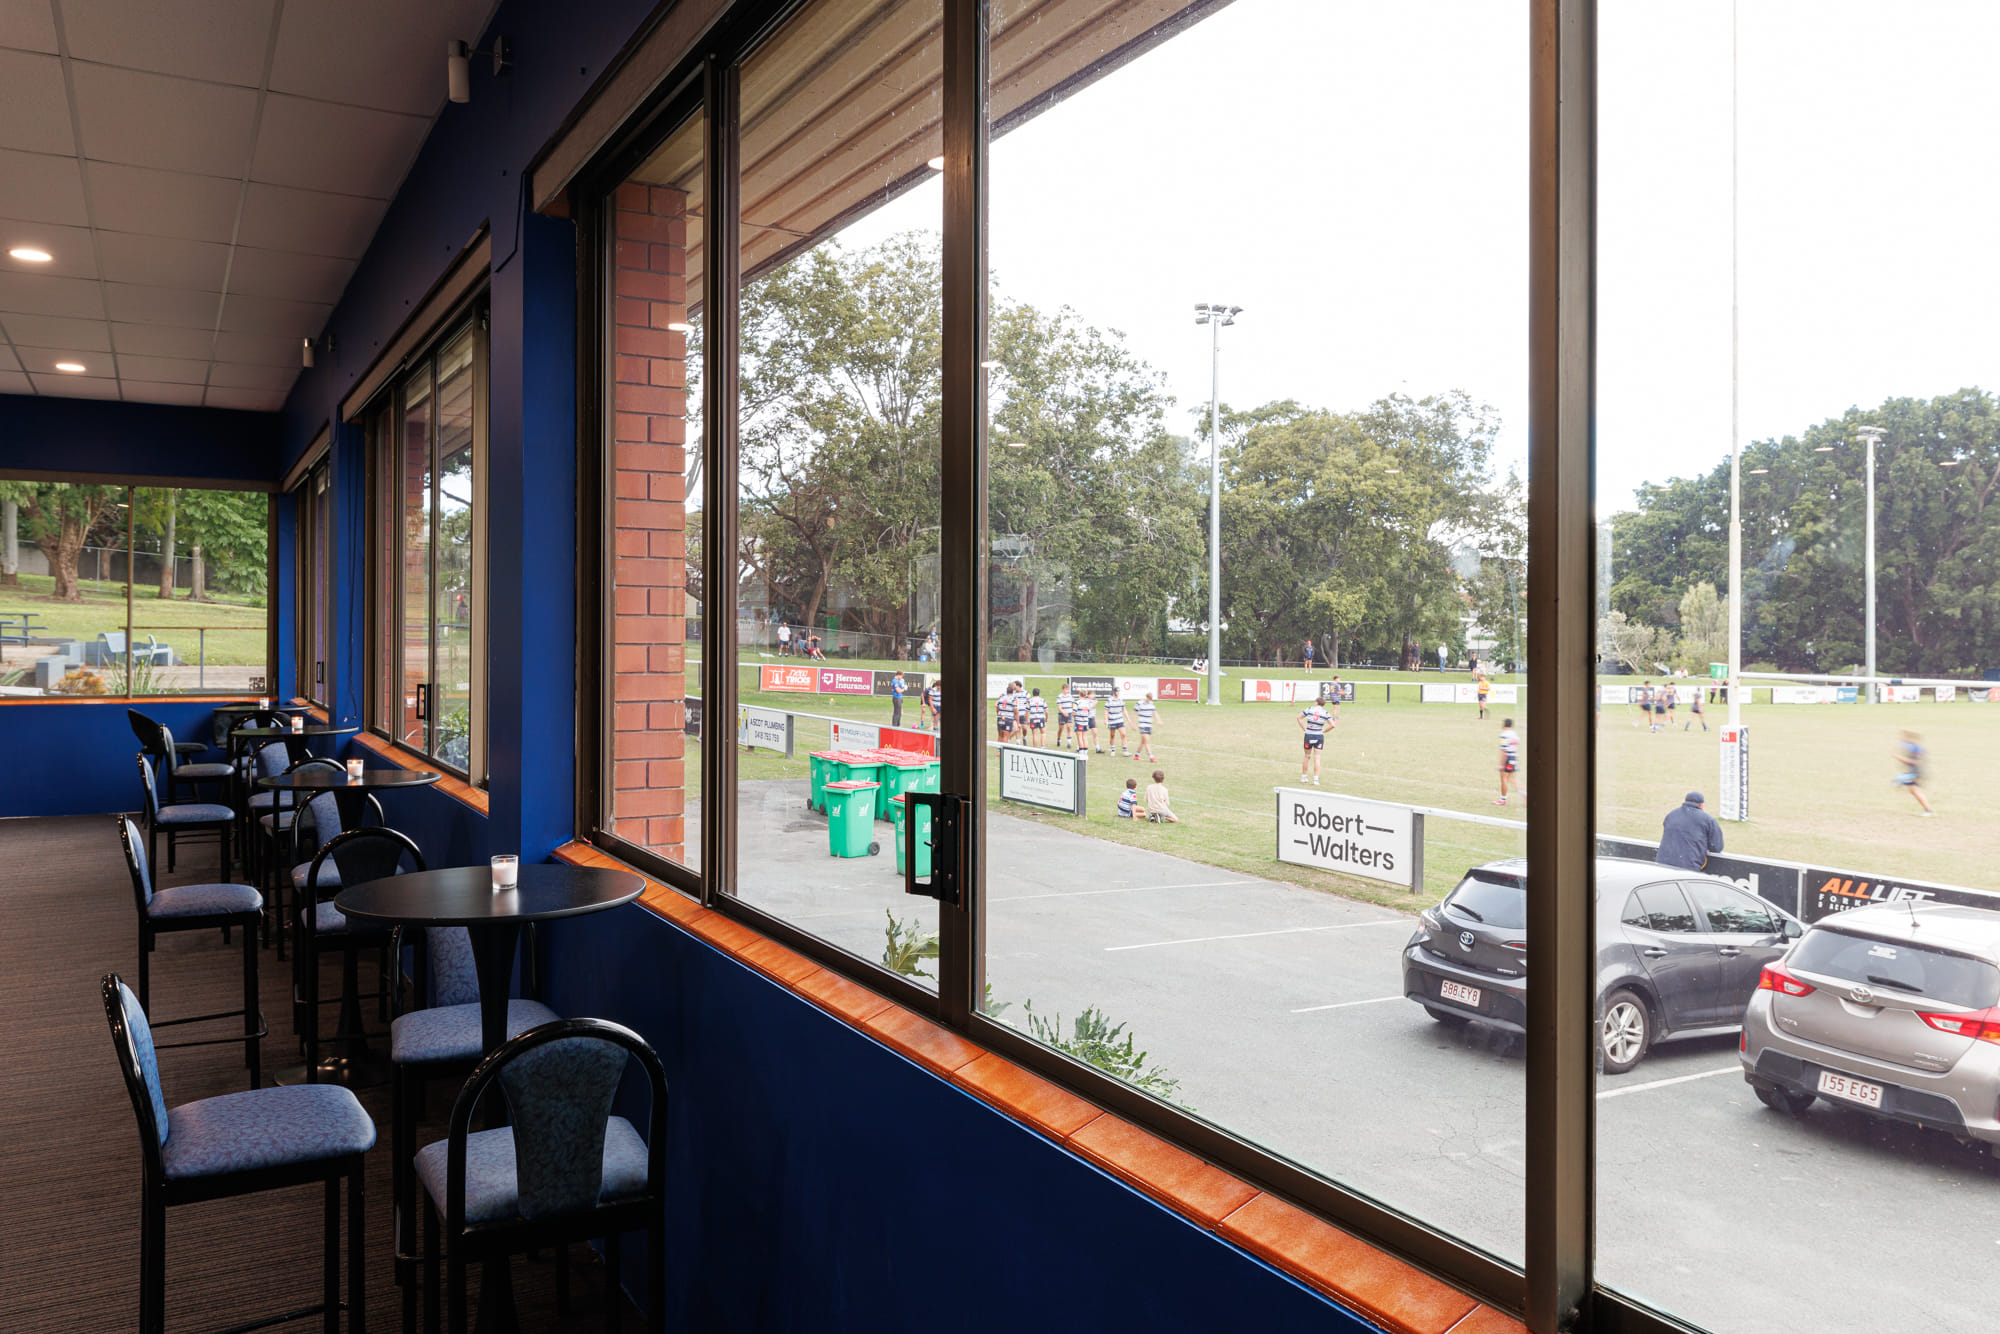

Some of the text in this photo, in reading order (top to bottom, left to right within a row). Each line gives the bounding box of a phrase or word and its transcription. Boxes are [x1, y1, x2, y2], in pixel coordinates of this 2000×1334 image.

[786, 676, 811, 685] TRICKS
[835, 674, 863, 682] Herron
[835, 682, 870, 691] Insurance
[1312, 711, 1320, 721] 5
[750, 718, 785, 732] ASCOT PLUMBING
[1010, 754, 1066, 780] HANNAY
[1023, 775, 1049, 786] LAWYERS
[1818, 893, 1872, 906] FORK
[1443, 982, 1458, 996] 588
[1823, 1074, 1879, 1102] 155 EG5
